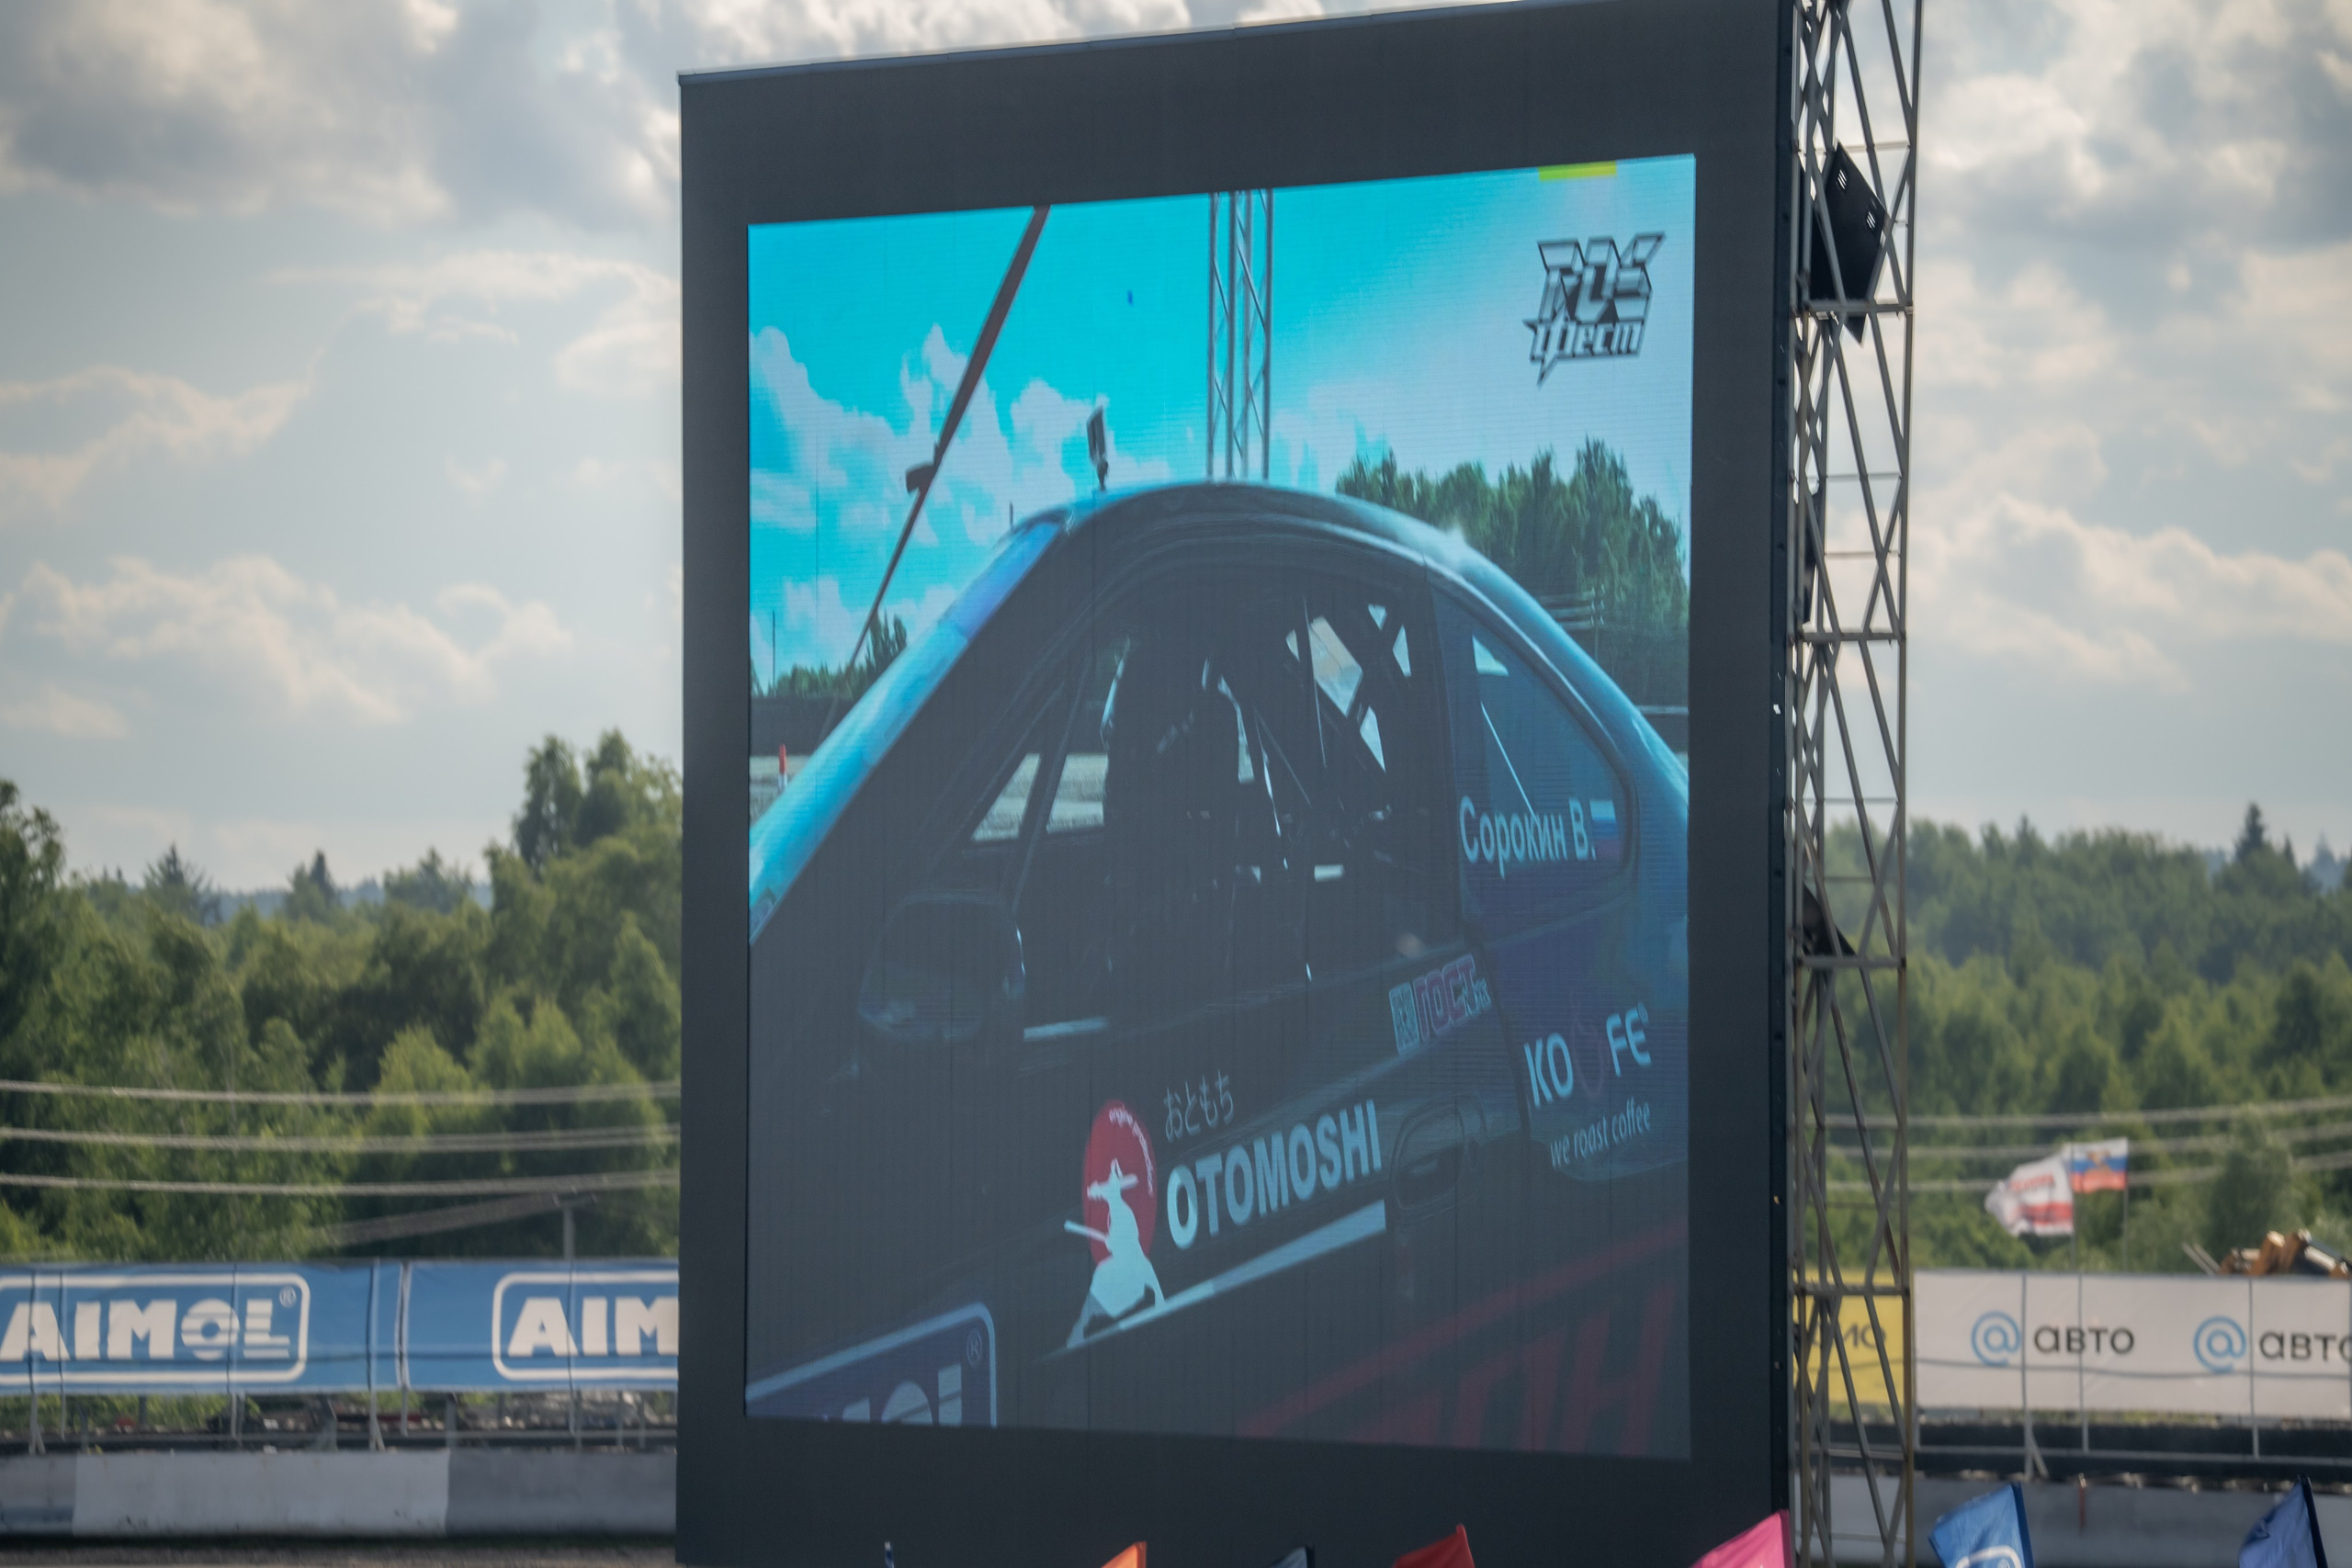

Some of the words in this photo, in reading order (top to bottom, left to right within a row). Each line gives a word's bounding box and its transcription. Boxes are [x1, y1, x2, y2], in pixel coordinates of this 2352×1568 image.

[1459, 795, 1569, 879] Сорокин
[1166, 1098, 1383, 1250] OTOMOSHI
[1550, 1134, 1571, 1170] we
[1573, 1115, 1610, 1160] roast
[1611, 1096, 1652, 1145] coffee
